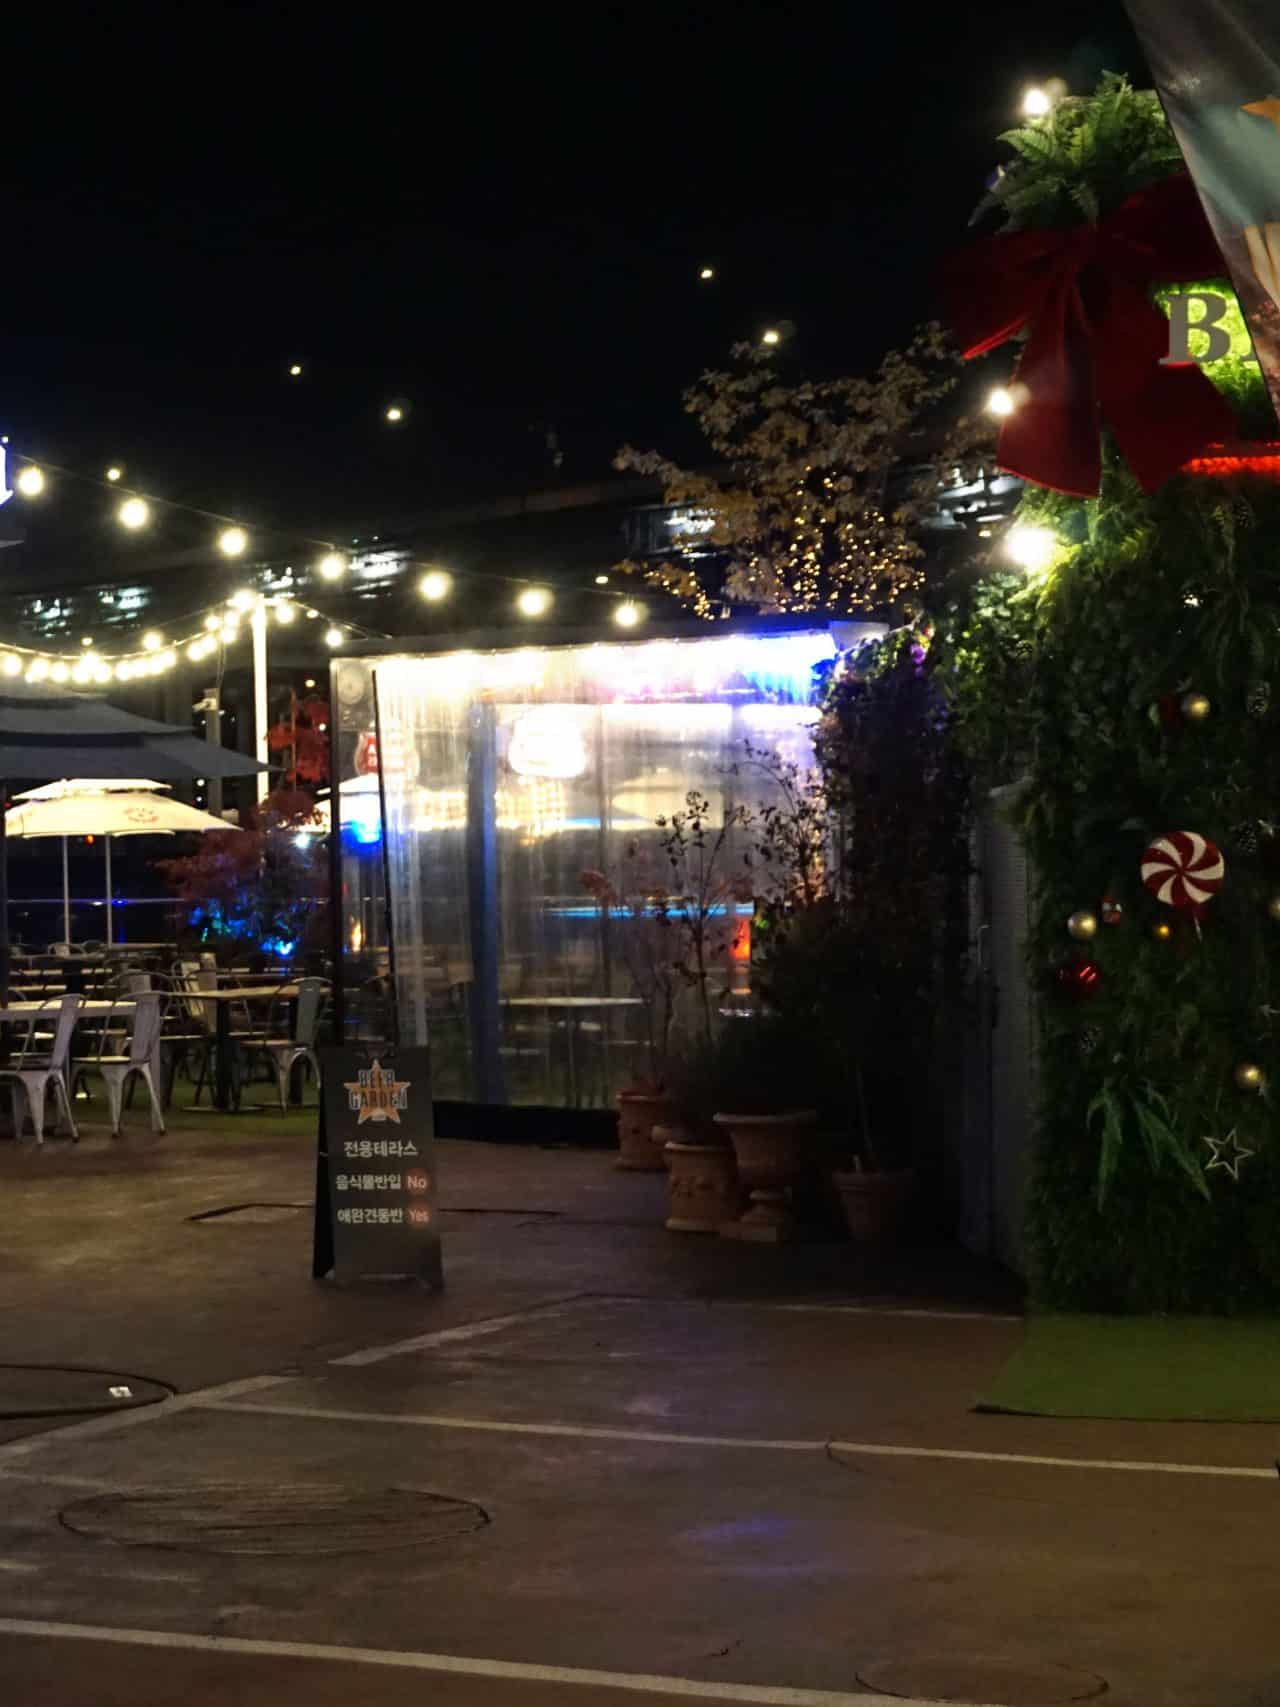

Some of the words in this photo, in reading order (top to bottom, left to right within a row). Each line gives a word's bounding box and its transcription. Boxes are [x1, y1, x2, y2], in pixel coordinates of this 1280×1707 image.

[1159, 293, 1257, 367] B
[343, 1140, 419, 1158] 전용테라스
[335, 1174, 402, 1191] 음식물반입
[406, 1174, 427, 1190] No
[407, 1207, 430, 1224] Yes
